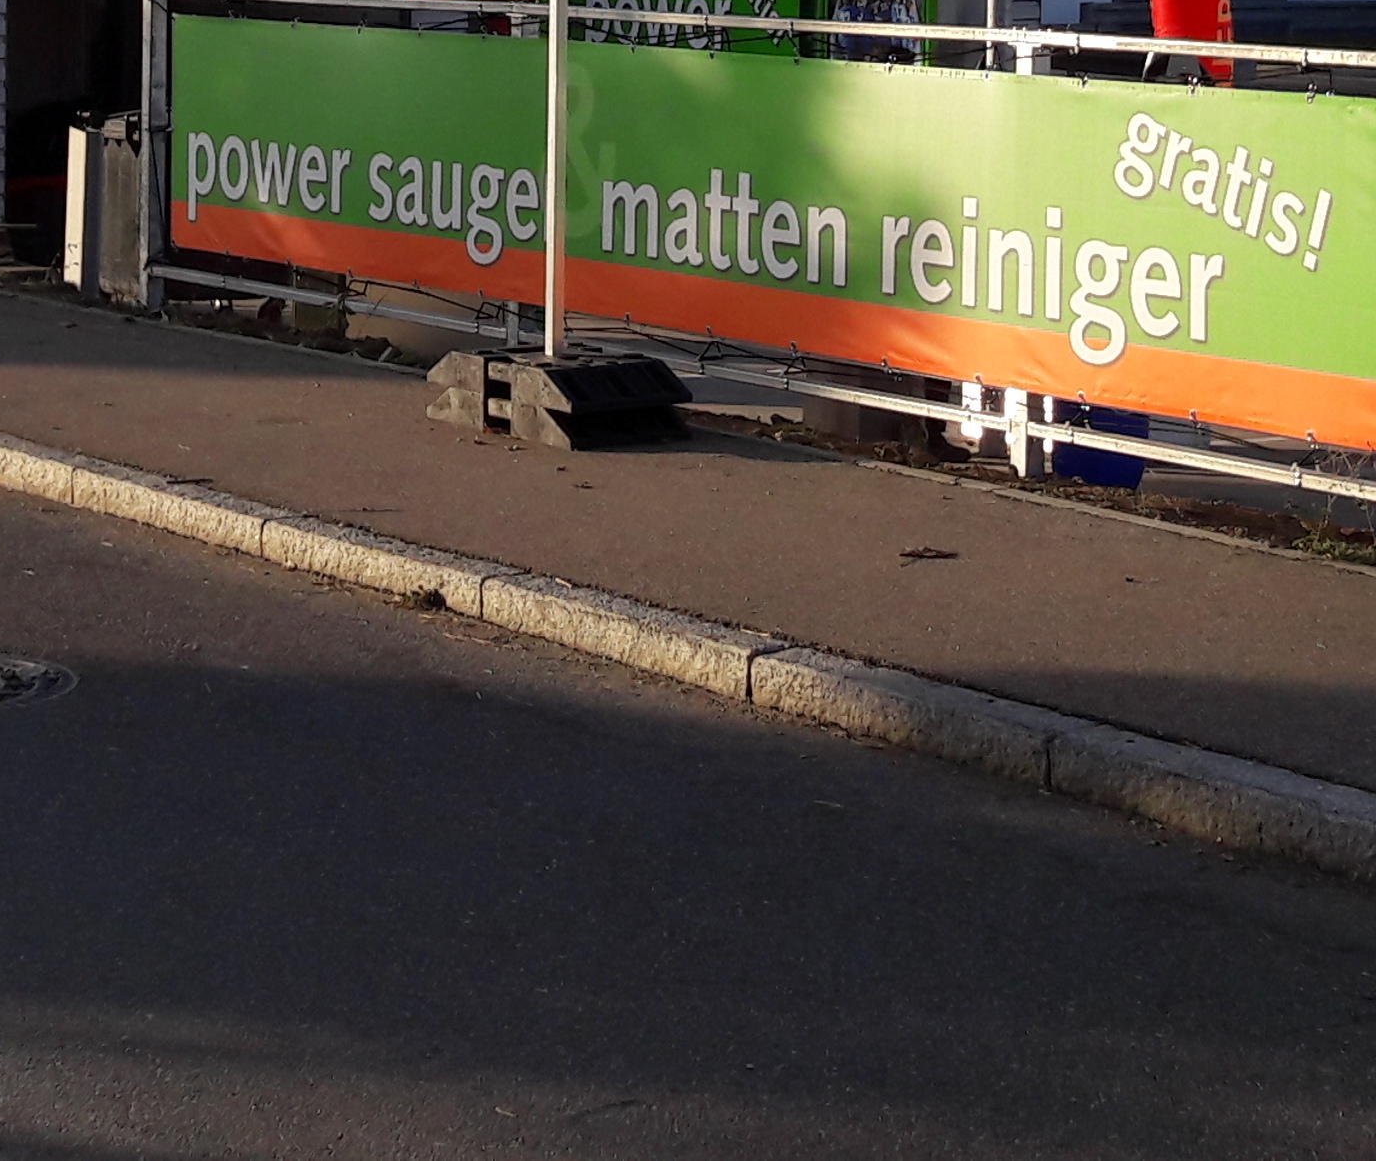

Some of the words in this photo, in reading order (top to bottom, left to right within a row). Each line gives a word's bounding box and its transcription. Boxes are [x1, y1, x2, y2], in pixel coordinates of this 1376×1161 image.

[187, 131, 352, 223] power
[368, 151, 546, 266] sauge
[601, 168, 848, 287] matten
[880, 196, 1225, 366] reiniger
[1113, 111, 1333, 272] gratis!
